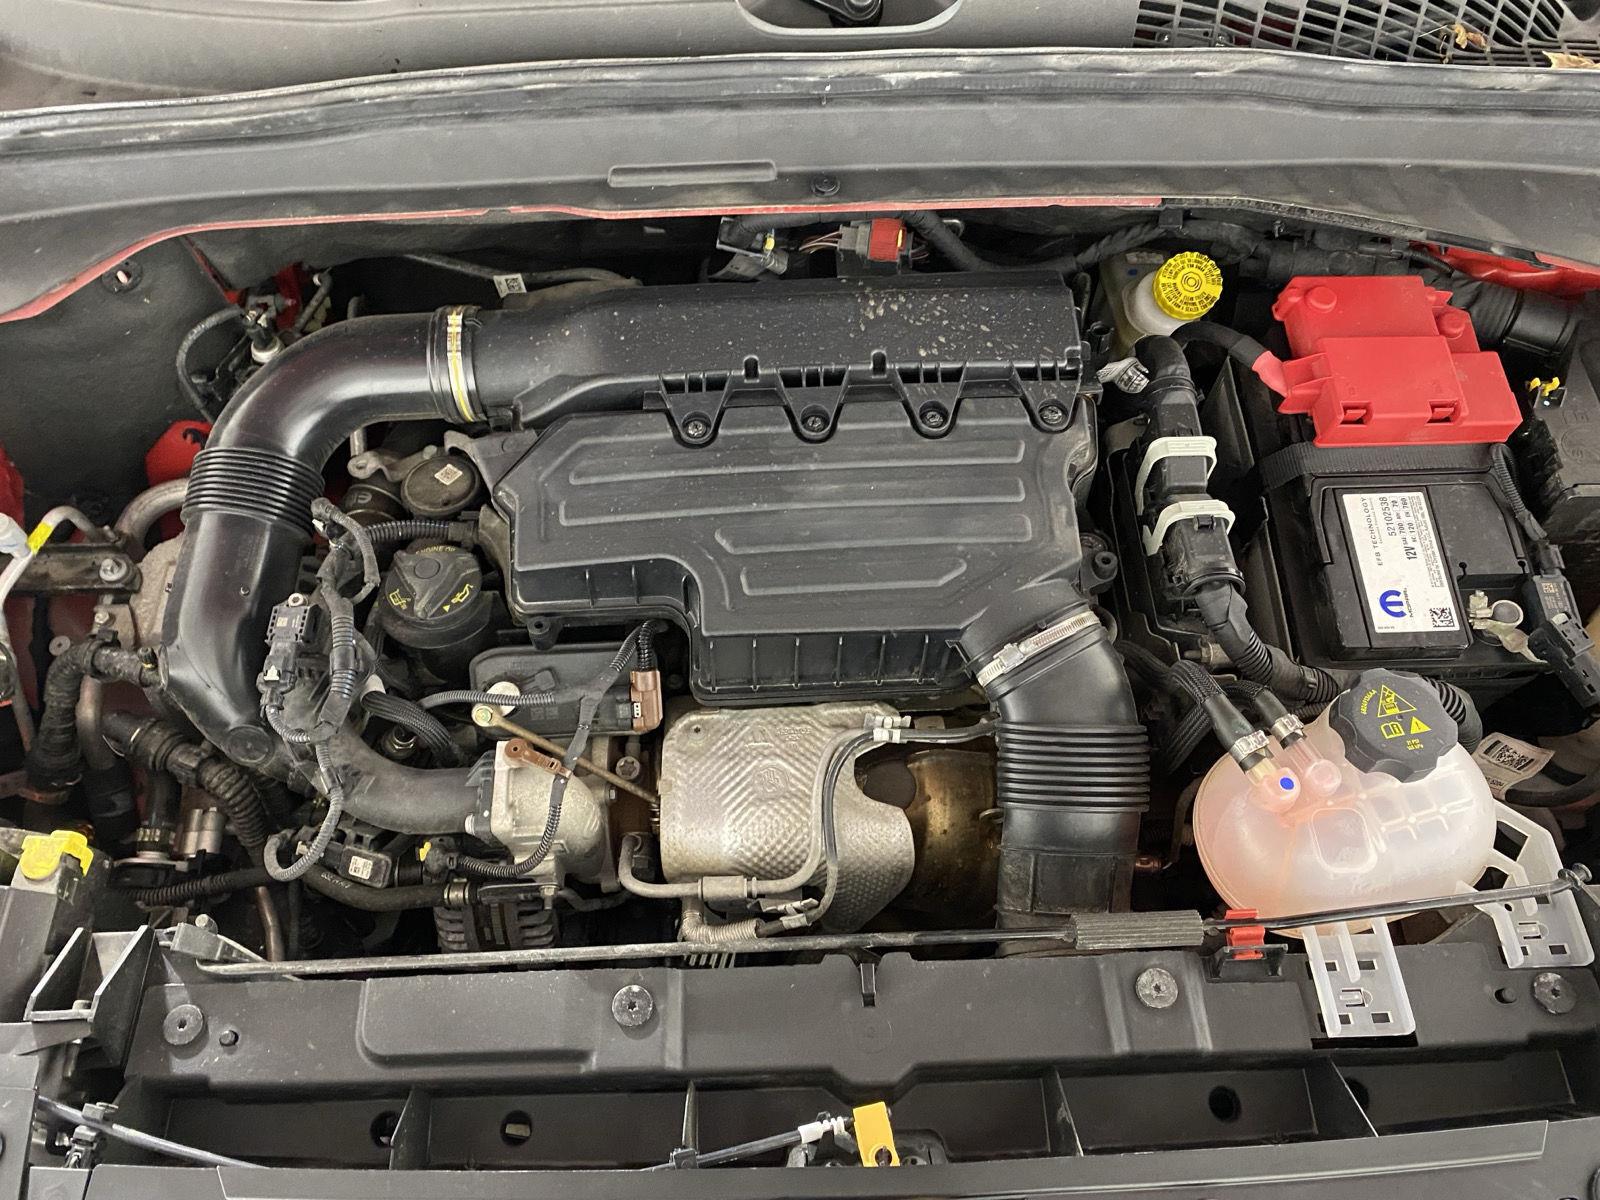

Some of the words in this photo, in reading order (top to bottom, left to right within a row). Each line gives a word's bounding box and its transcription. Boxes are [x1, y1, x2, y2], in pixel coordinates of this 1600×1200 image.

[1360, 496, 1379, 549] TECHNOLOGY
[1379, 496, 1397, 537] 52102538
[1397, 522, 1407, 535] 700
[1404, 545, 1418, 560] 12V
